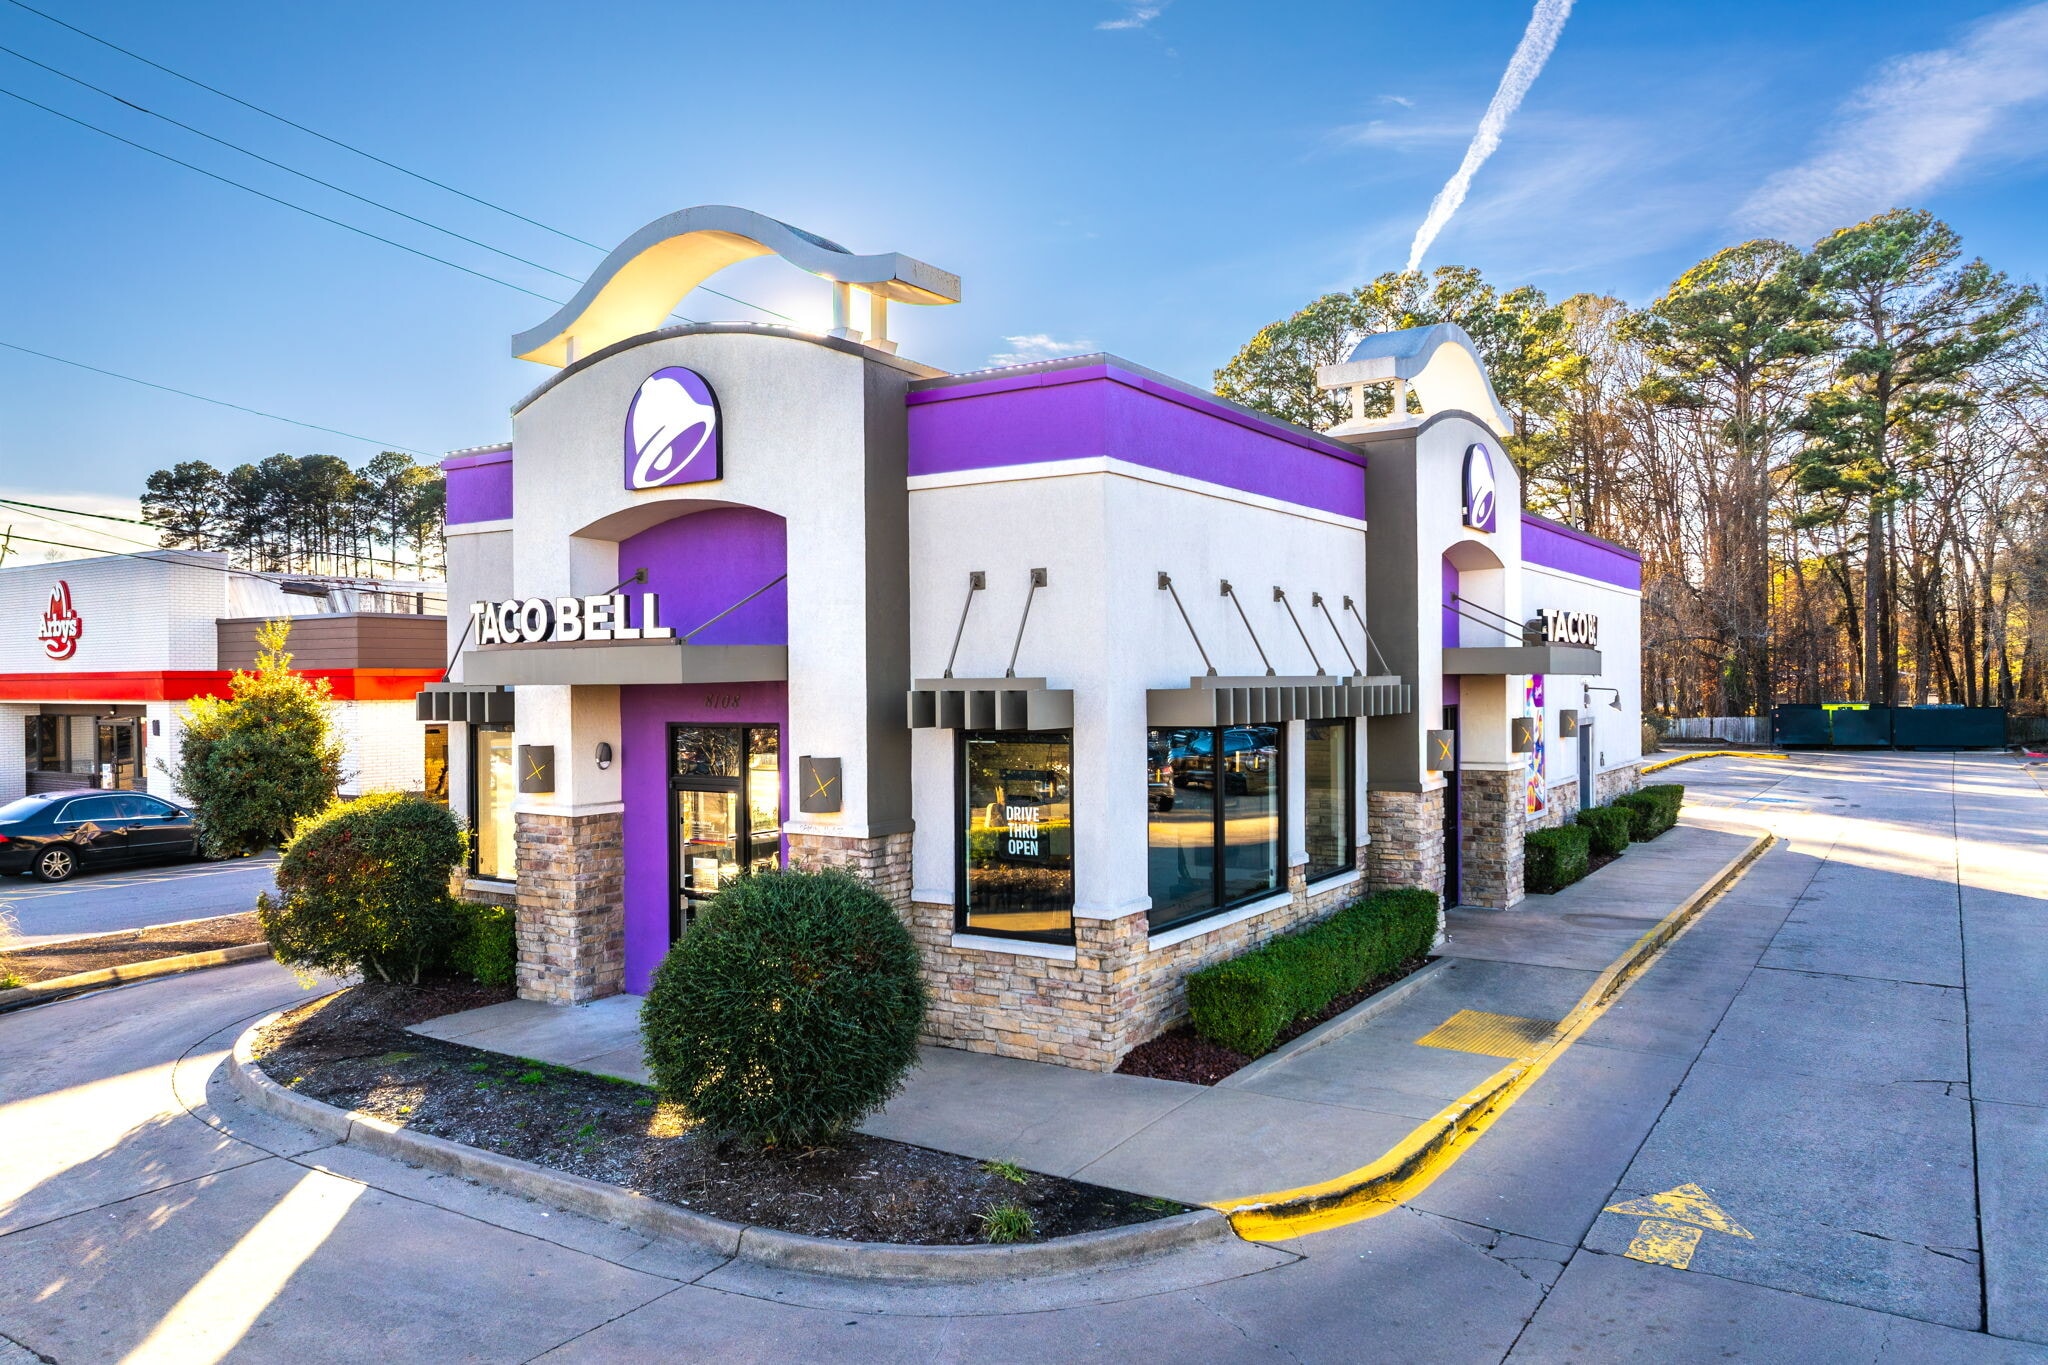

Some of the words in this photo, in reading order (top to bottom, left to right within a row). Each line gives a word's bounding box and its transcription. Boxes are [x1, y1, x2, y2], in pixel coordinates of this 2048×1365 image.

[38, 611, 77, 643] Arby's
[470, 597, 552, 645] TACO
[556, 593, 674, 641] BELL
[1541, 608, 1588, 644] TACO
[703, 693, 742, 709] 8108
[1006, 805, 1040, 822] DRIVE
[1007, 822, 1038, 839] THRU
[1008, 839, 1039, 856] OPEN
